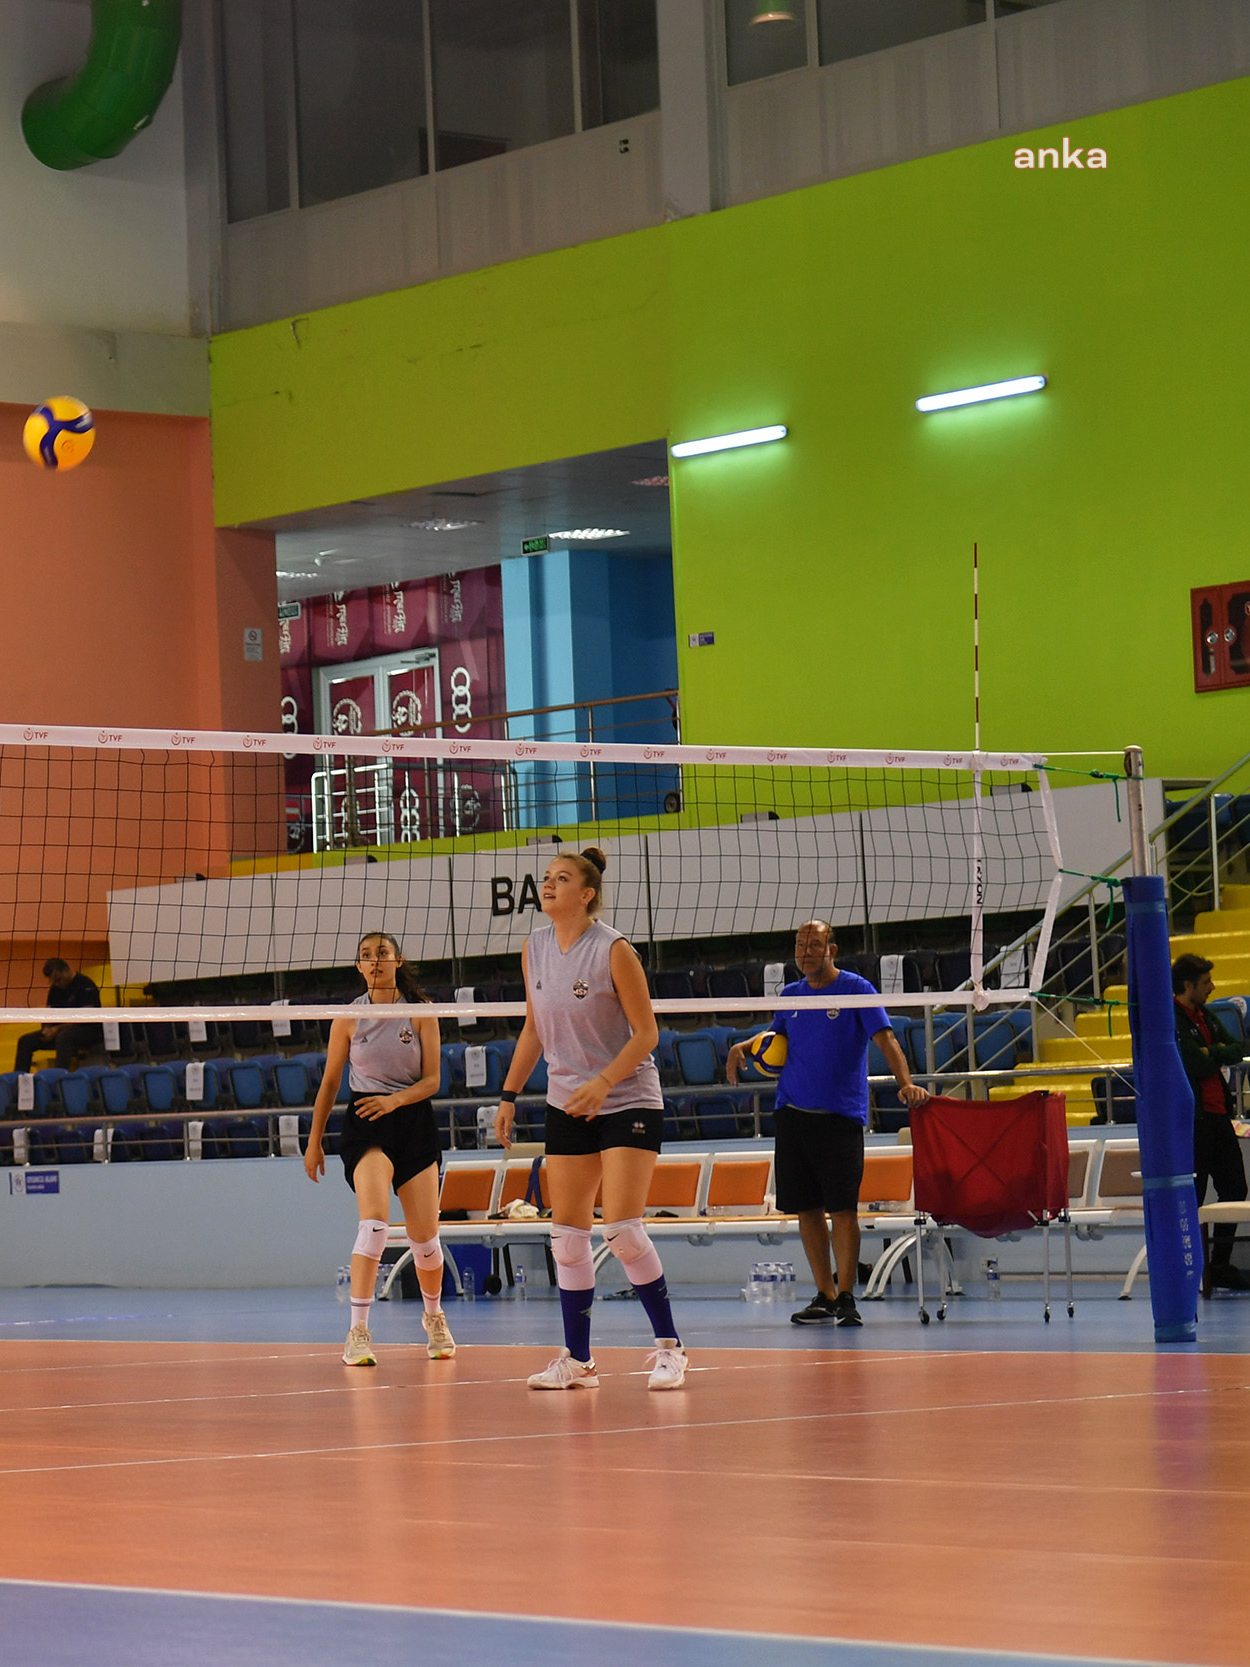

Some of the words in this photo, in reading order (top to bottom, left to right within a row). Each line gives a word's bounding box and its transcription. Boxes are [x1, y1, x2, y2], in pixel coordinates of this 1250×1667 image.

[34, 731, 48, 739] TVF
[109, 734, 123, 742] TVF
[182, 736, 195, 744] TVF
[392, 743, 405, 751] TVF
[459, 745, 472, 753] TVF
[491, 873, 542, 916] BA
